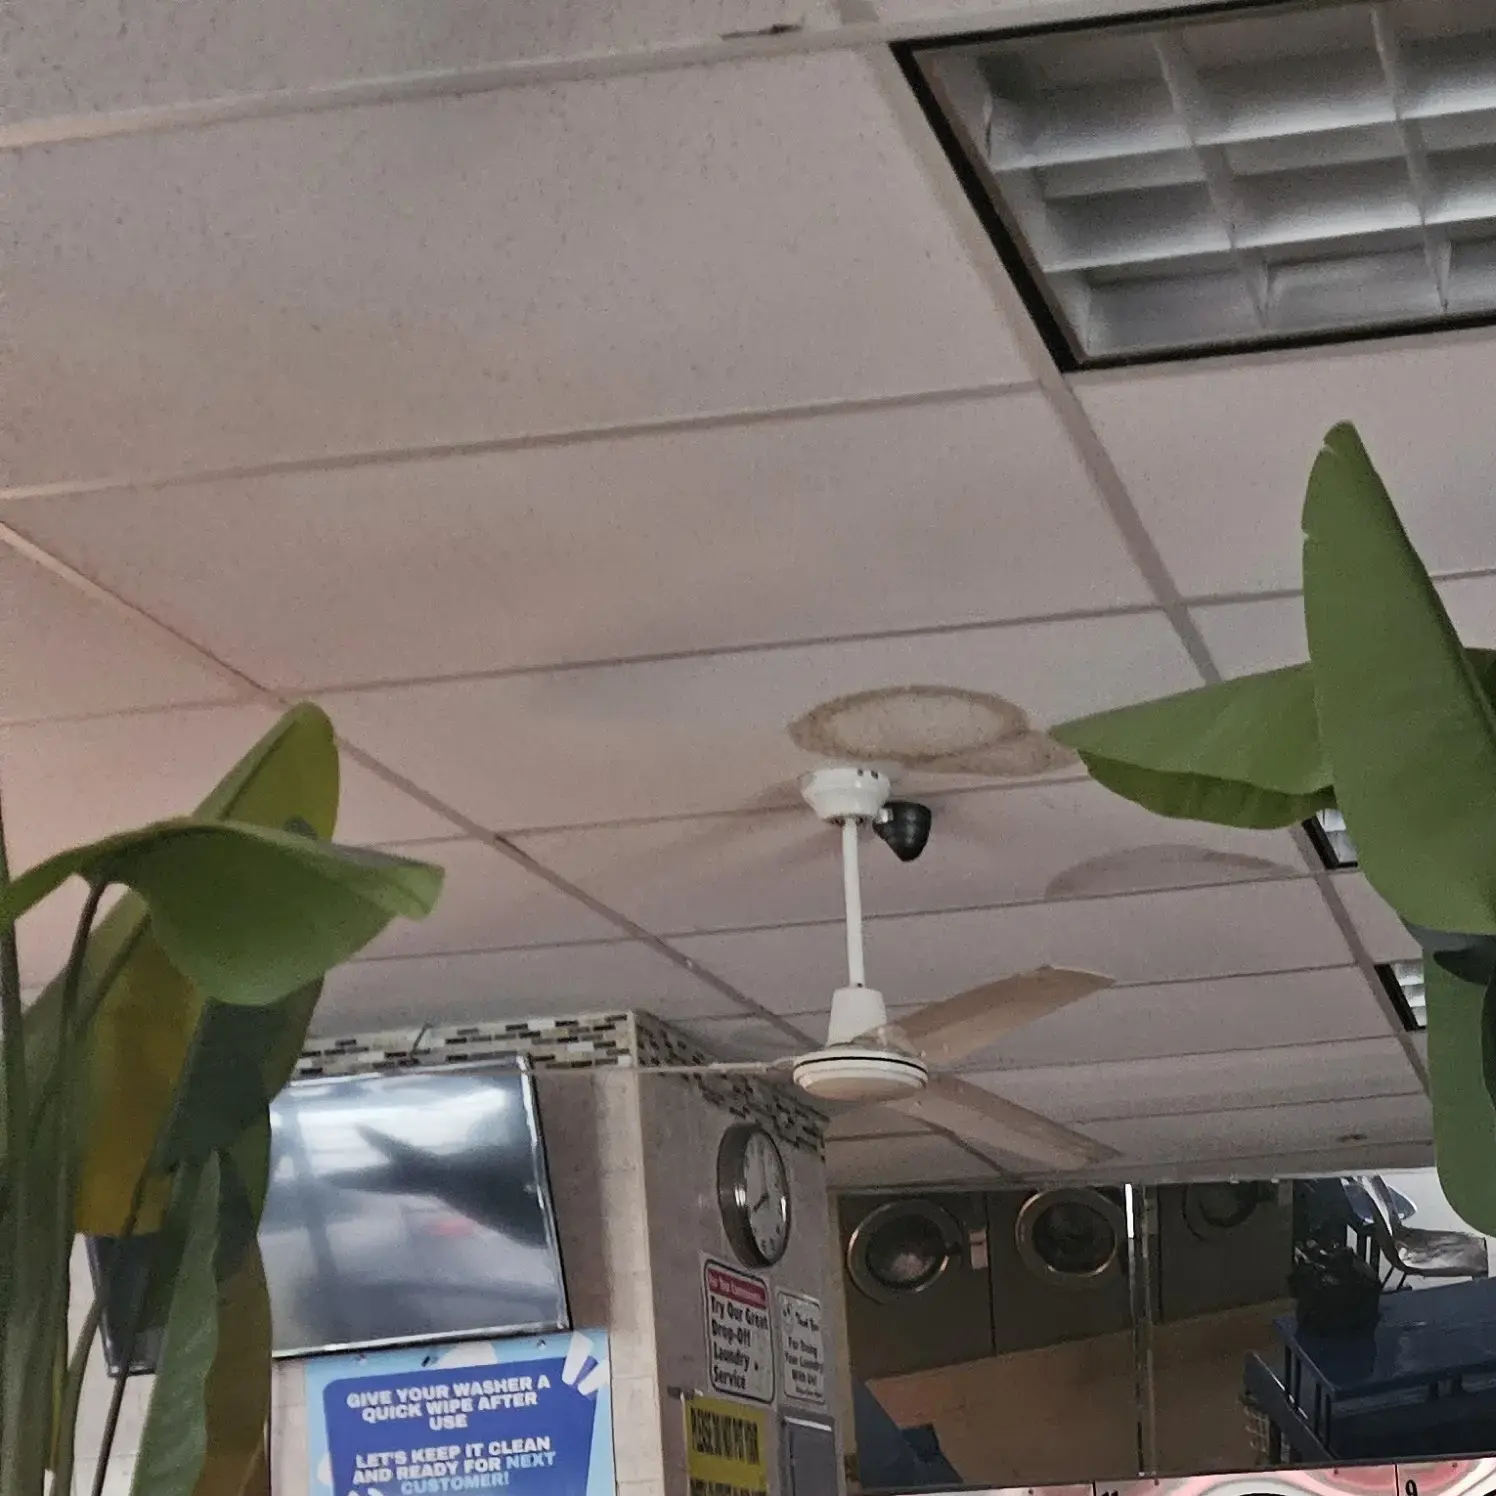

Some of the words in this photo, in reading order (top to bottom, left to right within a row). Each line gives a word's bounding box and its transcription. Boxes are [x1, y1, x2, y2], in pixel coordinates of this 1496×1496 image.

[711, 1295, 724, 1320] Try
[727, 1302, 743, 1321] Our
[745, 1308, 768, 1330] Great
[711, 1319, 751, 1347] Drop-Off
[713, 1341, 750, 1372] Laundry
[347, 1390, 392, 1408] GIVE
[397, 1385, 450, 1403] YOUR
[453, 1376, 532, 1398] WASHER
[538, 1375, 550, 1389] A
[714, 1364, 746, 1389] Service
[362, 1404, 422, 1424] QUICK
[426, 1398, 473, 1415] WIPE
[478, 1391, 538, 1411] AFTER
[429, 1414, 468, 1431] USE
[356, 1451, 406, 1468] LET'S
[411, 1445, 460, 1463] KEEP
[465, 1443, 484, 1457] IT
[488, 1436, 550, 1455] CLEAN
[353, 1467, 392, 1485] AND
[396, 1461, 459, 1480] READY
[464, 1457, 500, 1474] FOR
[506, 1451, 556, 1469] NEXT
[401, 1471, 509, 1495] CUSTOMER!
